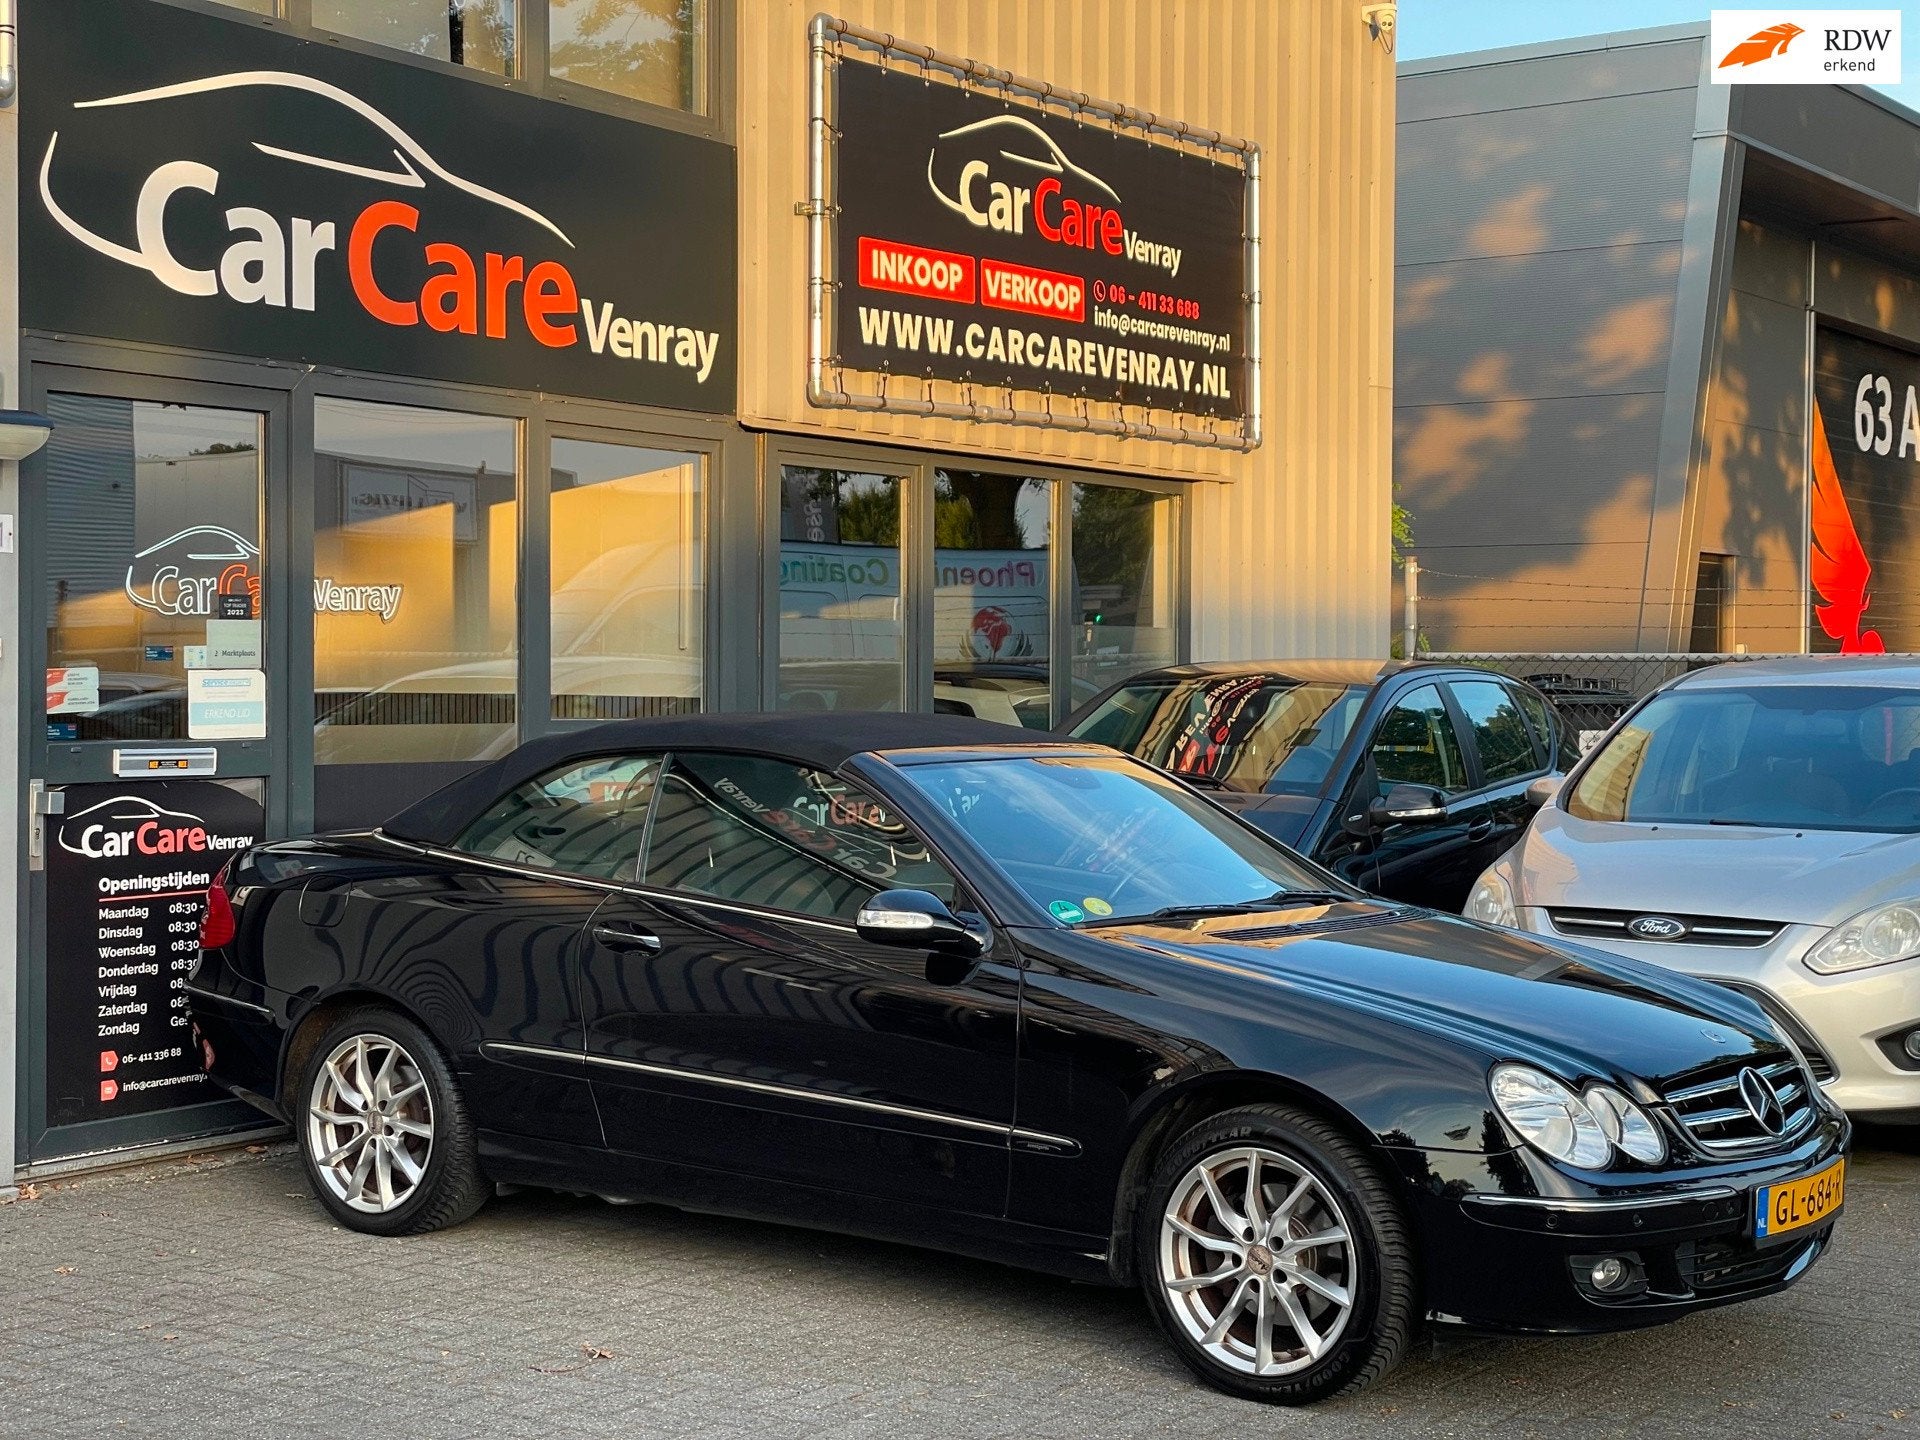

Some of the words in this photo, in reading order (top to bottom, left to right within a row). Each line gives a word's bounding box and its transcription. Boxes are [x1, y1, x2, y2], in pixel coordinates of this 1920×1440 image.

[1122, 231, 1182, 278] Venray
[871, 249, 963, 291] INKOOP
[984, 269, 1081, 312] VERKOOP
[1109, 284, 1125, 304] 06
[1138, 291, 1157, 311] 411
[1159, 294, 1174, 314] 33
[1176, 298, 1199, 320] 688
[580, 298, 719, 383] Venray
[1094, 305, 1230, 354] info@carcarevenray.nl
[858, 307, 1231, 398] WWW.CARCAREVENRAY.NL
[1855, 373, 1892, 455] 63
[1899, 385, 1920, 462] A
[314, 580, 401, 620] Venray
[99, 870, 210, 895] Openingstijden
[98, 905, 150, 920] Maandag
[168, 902, 198, 914] 08:30
[98, 925, 143, 940] Dinsdag
[168, 921, 197, 933] 08:30
[1640, 919, 1672, 934] Ford
[98, 943, 156, 959] Woensdag
[171, 939, 200, 951] 08:30
[98, 962, 159, 978] Donderdag
[98, 983, 137, 999] Vrijdag
[98, 1001, 148, 1018] Zaterdag
[98, 1021, 140, 1037] Zondag
[138, 1052, 152, 1063] 411
[170, 1047, 182, 1057] 88
[1757, 1217, 1767, 1229] NL
